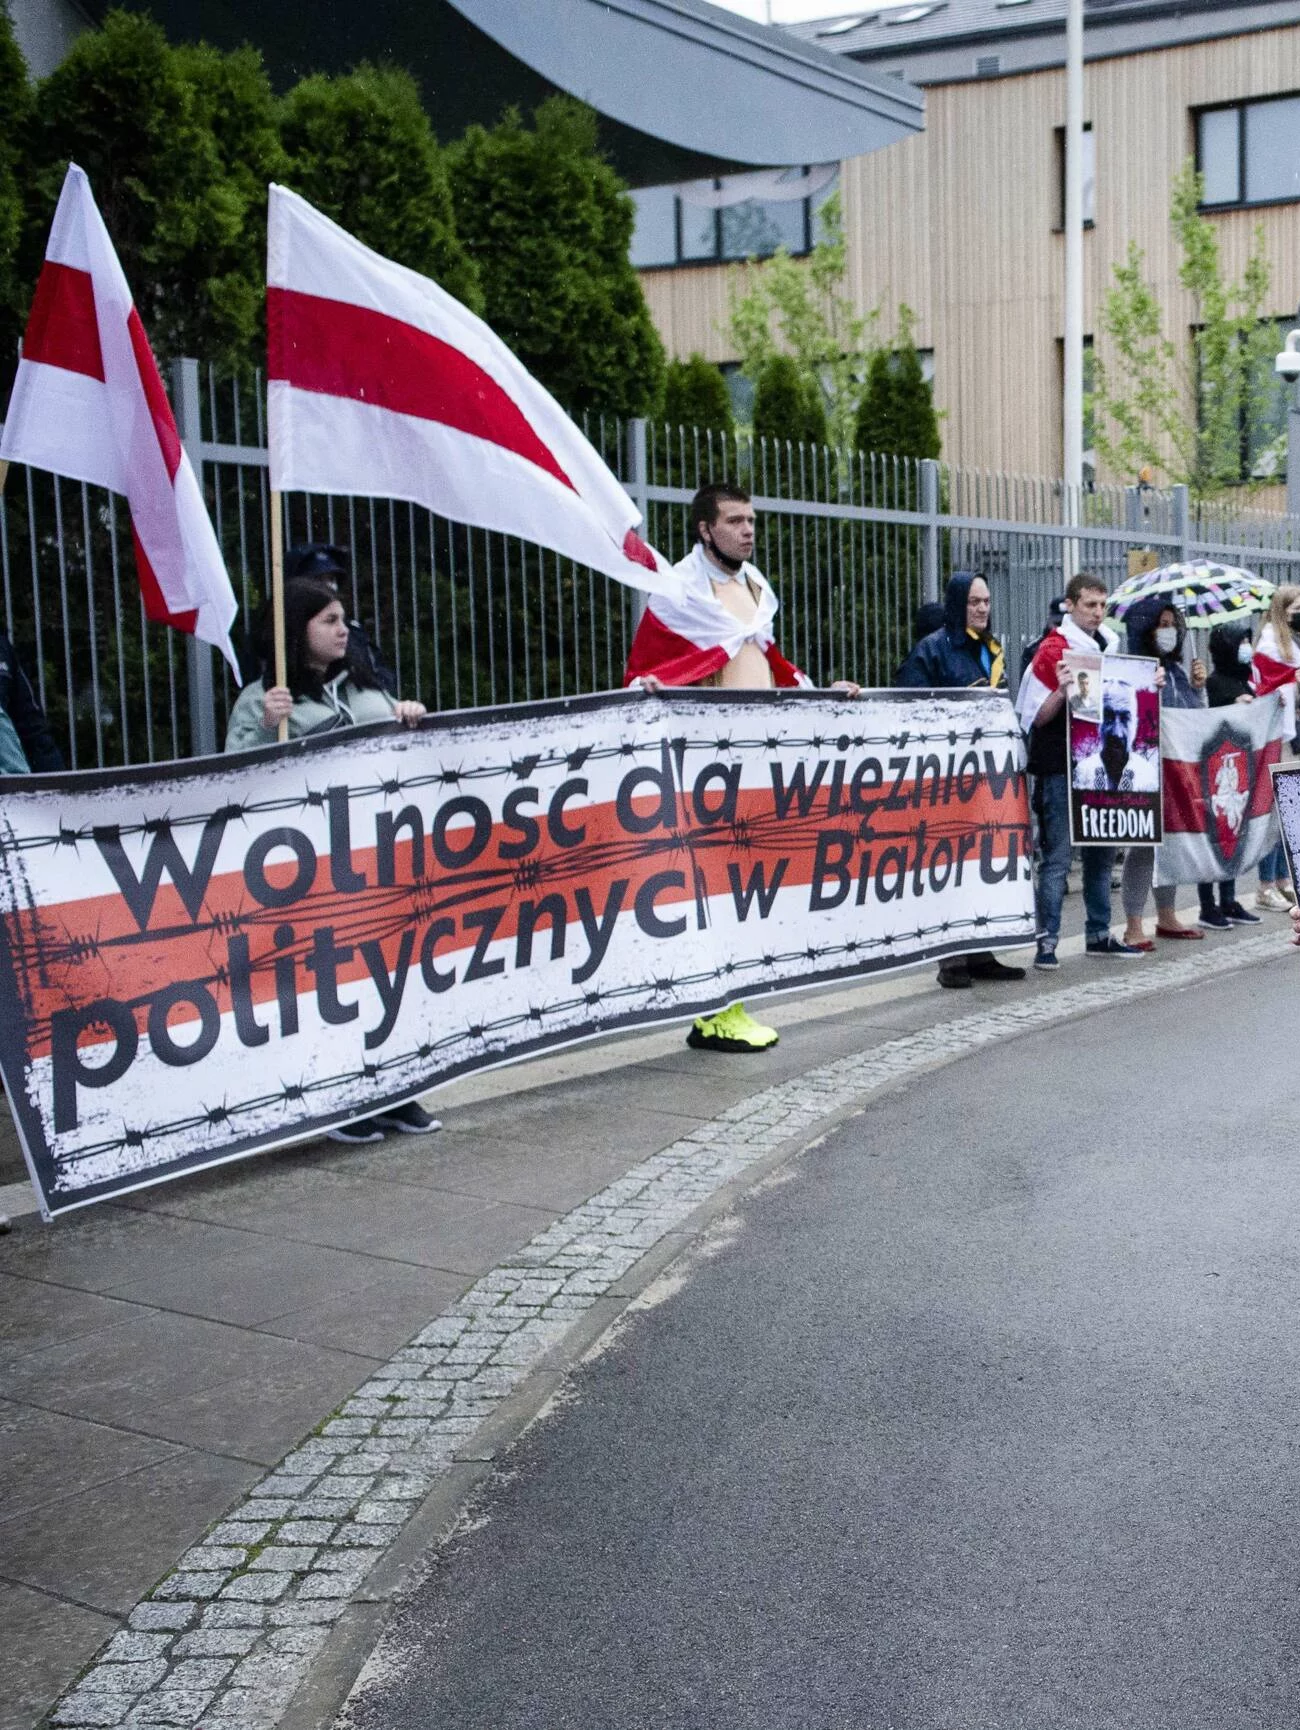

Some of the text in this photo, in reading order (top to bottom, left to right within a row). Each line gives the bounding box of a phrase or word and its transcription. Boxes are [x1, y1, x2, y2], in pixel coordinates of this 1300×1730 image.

[93, 745, 596, 932] Wolność
[770, 727, 1021, 842] więźniów
[1081, 804, 1155, 839] FREEDOM
[727, 858, 791, 922] w
